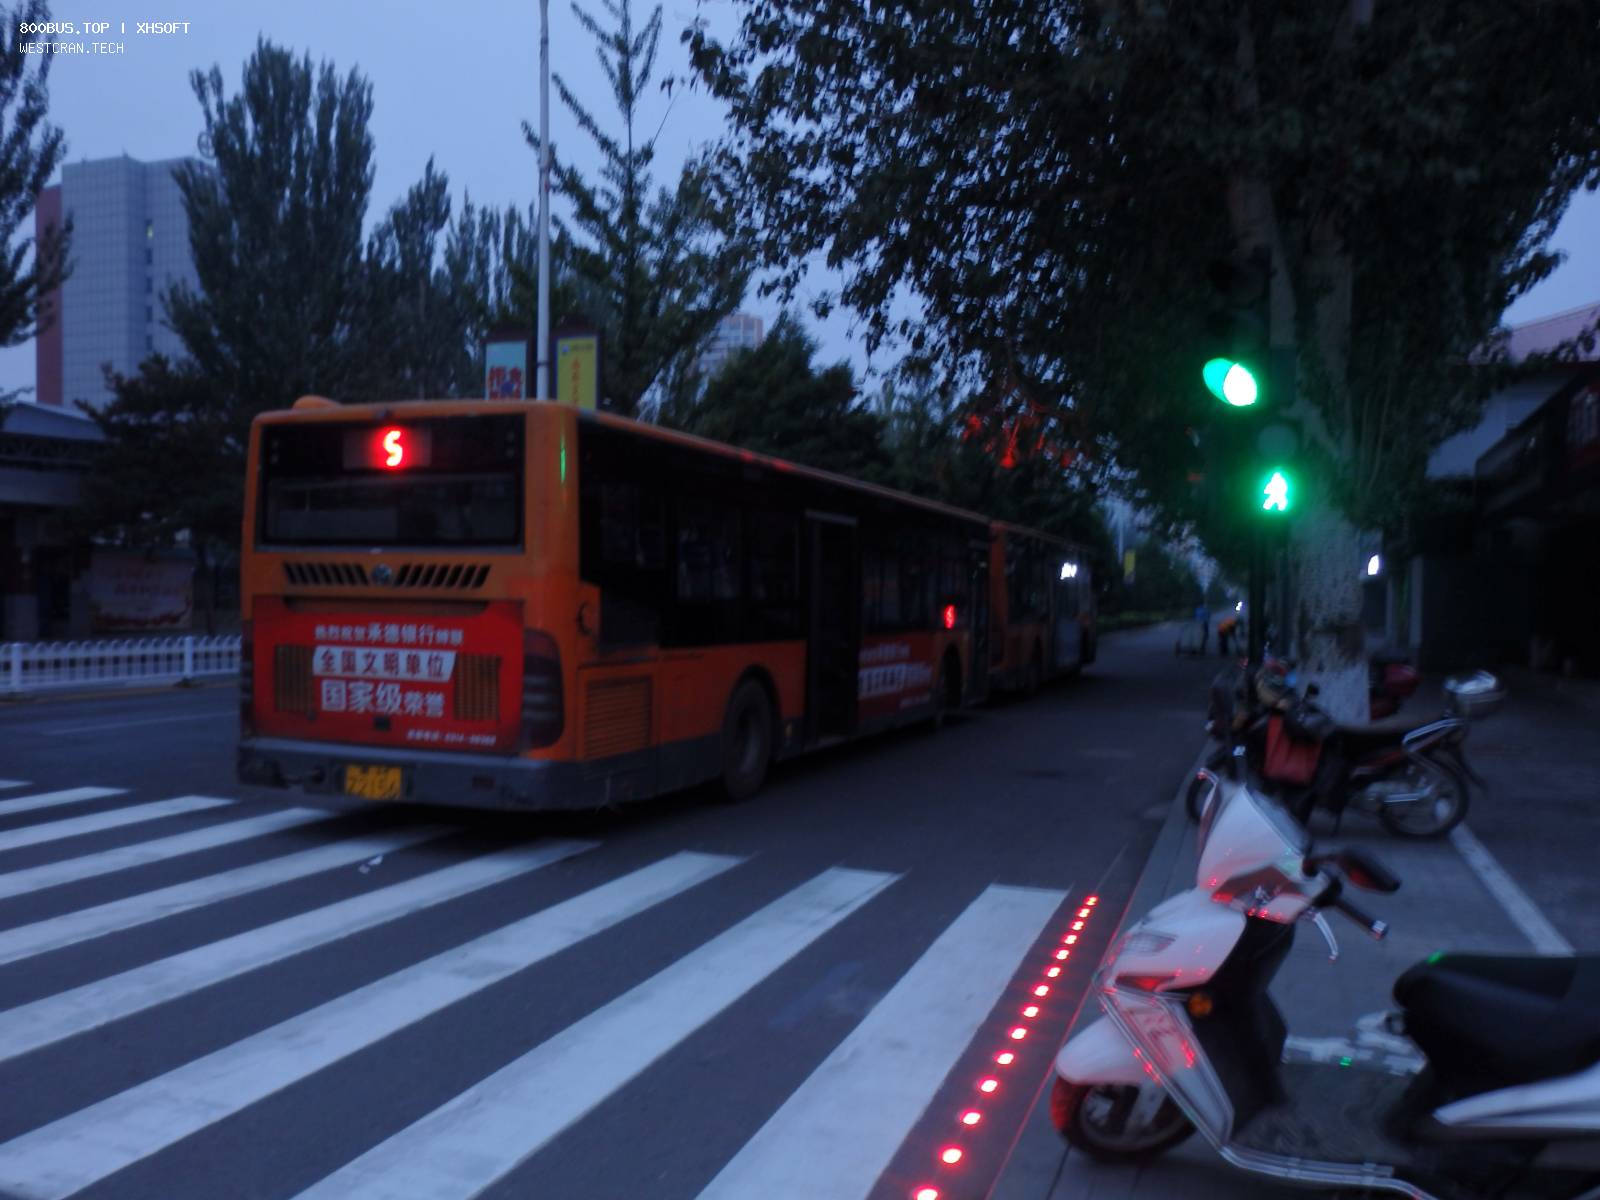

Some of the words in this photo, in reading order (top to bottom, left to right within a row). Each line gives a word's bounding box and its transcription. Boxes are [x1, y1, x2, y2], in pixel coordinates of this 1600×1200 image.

[320, 650, 444, 676] 全国文明单位
[321, 680, 445, 717] 国家级荣誉
